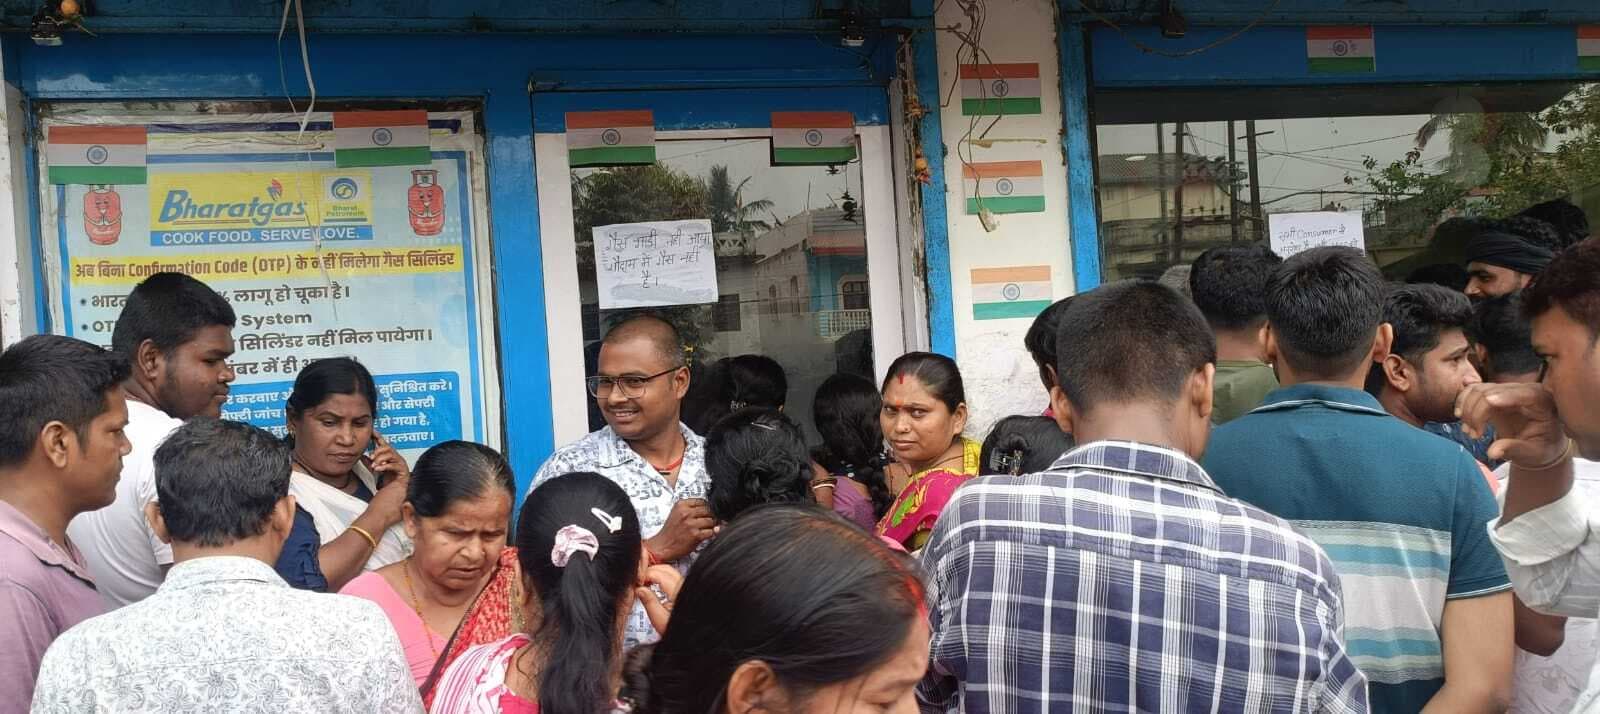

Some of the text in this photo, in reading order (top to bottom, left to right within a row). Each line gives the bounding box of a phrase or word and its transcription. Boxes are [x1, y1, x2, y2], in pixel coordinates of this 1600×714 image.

[158, 189, 308, 226] Bharatgas
[162, 232, 204, 245] COOK
[209, 230, 256, 243] FOOD.
[261, 229, 311, 241] SERVE
[75, 263, 94, 277] अब
[98, 260, 125, 277] बिना
[129, 260, 210, 276] Confirmation
[214, 259, 247, 274] Code
[252, 255, 291, 275] (OTP)
[295, 254, 308, 270] के
[340, 252, 380, 269] मिलेगा
[383, 251, 404, 268] गैस
[408, 248, 455, 267] सिलिंडर
[234, 288, 273, 306] लागू
[275, 284, 290, 302] हो
[293, 285, 328, 304] चूका
[92, 313, 312, 332] OT System
[240, 331, 304, 351] सिलिंडर
[306, 328, 337, 347] नहीं
[338, 329, 373, 344] मिल
[262, 356, 279, 373] में
[281, 355, 297, 373] ही
[382, 398, 402, 410] और
[380, 414, 391, 428] हो
[394, 415, 417, 427] गया
